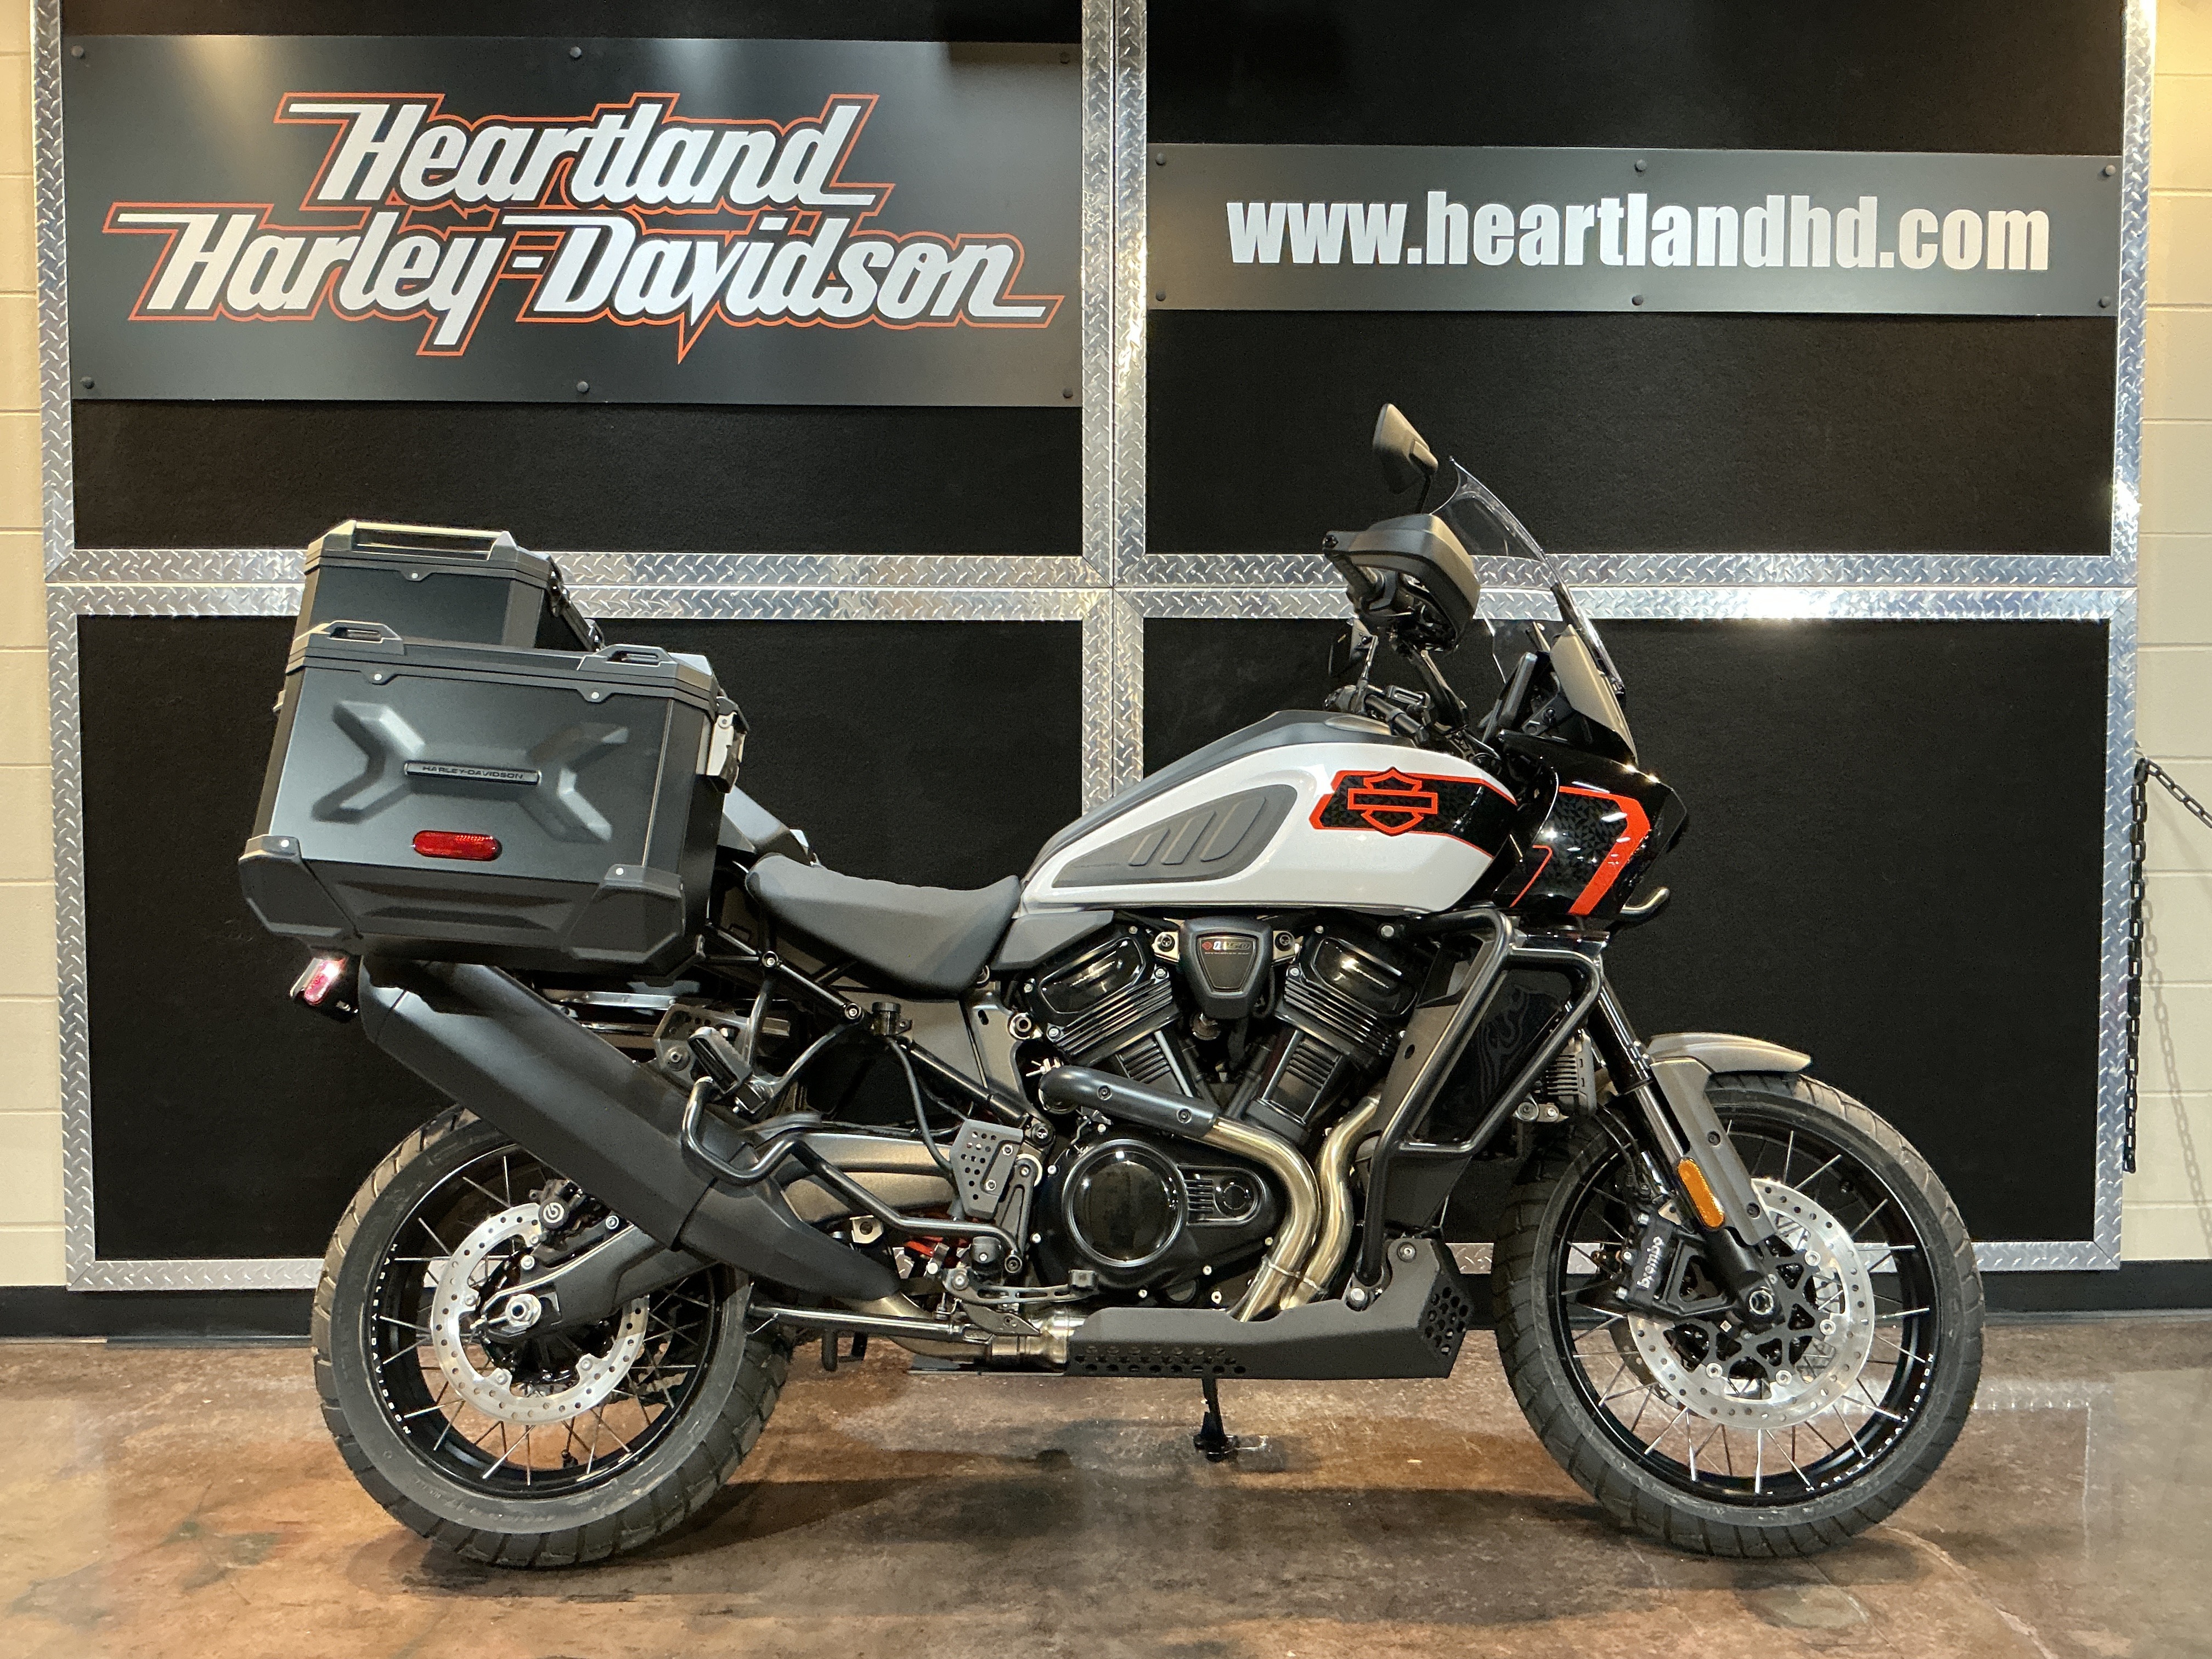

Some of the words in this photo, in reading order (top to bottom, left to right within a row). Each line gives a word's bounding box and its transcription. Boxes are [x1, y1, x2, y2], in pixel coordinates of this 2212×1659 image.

[286, 102, 876, 206] Heartland
[1226, 191, 2050, 271] www.heartlandhd.com
[116, 212, 1047, 346] Harley-Davidson
[422, 765, 523, 780] HARLEY-DAVIDSON
[1636, 1235, 1664, 1289] brembo
